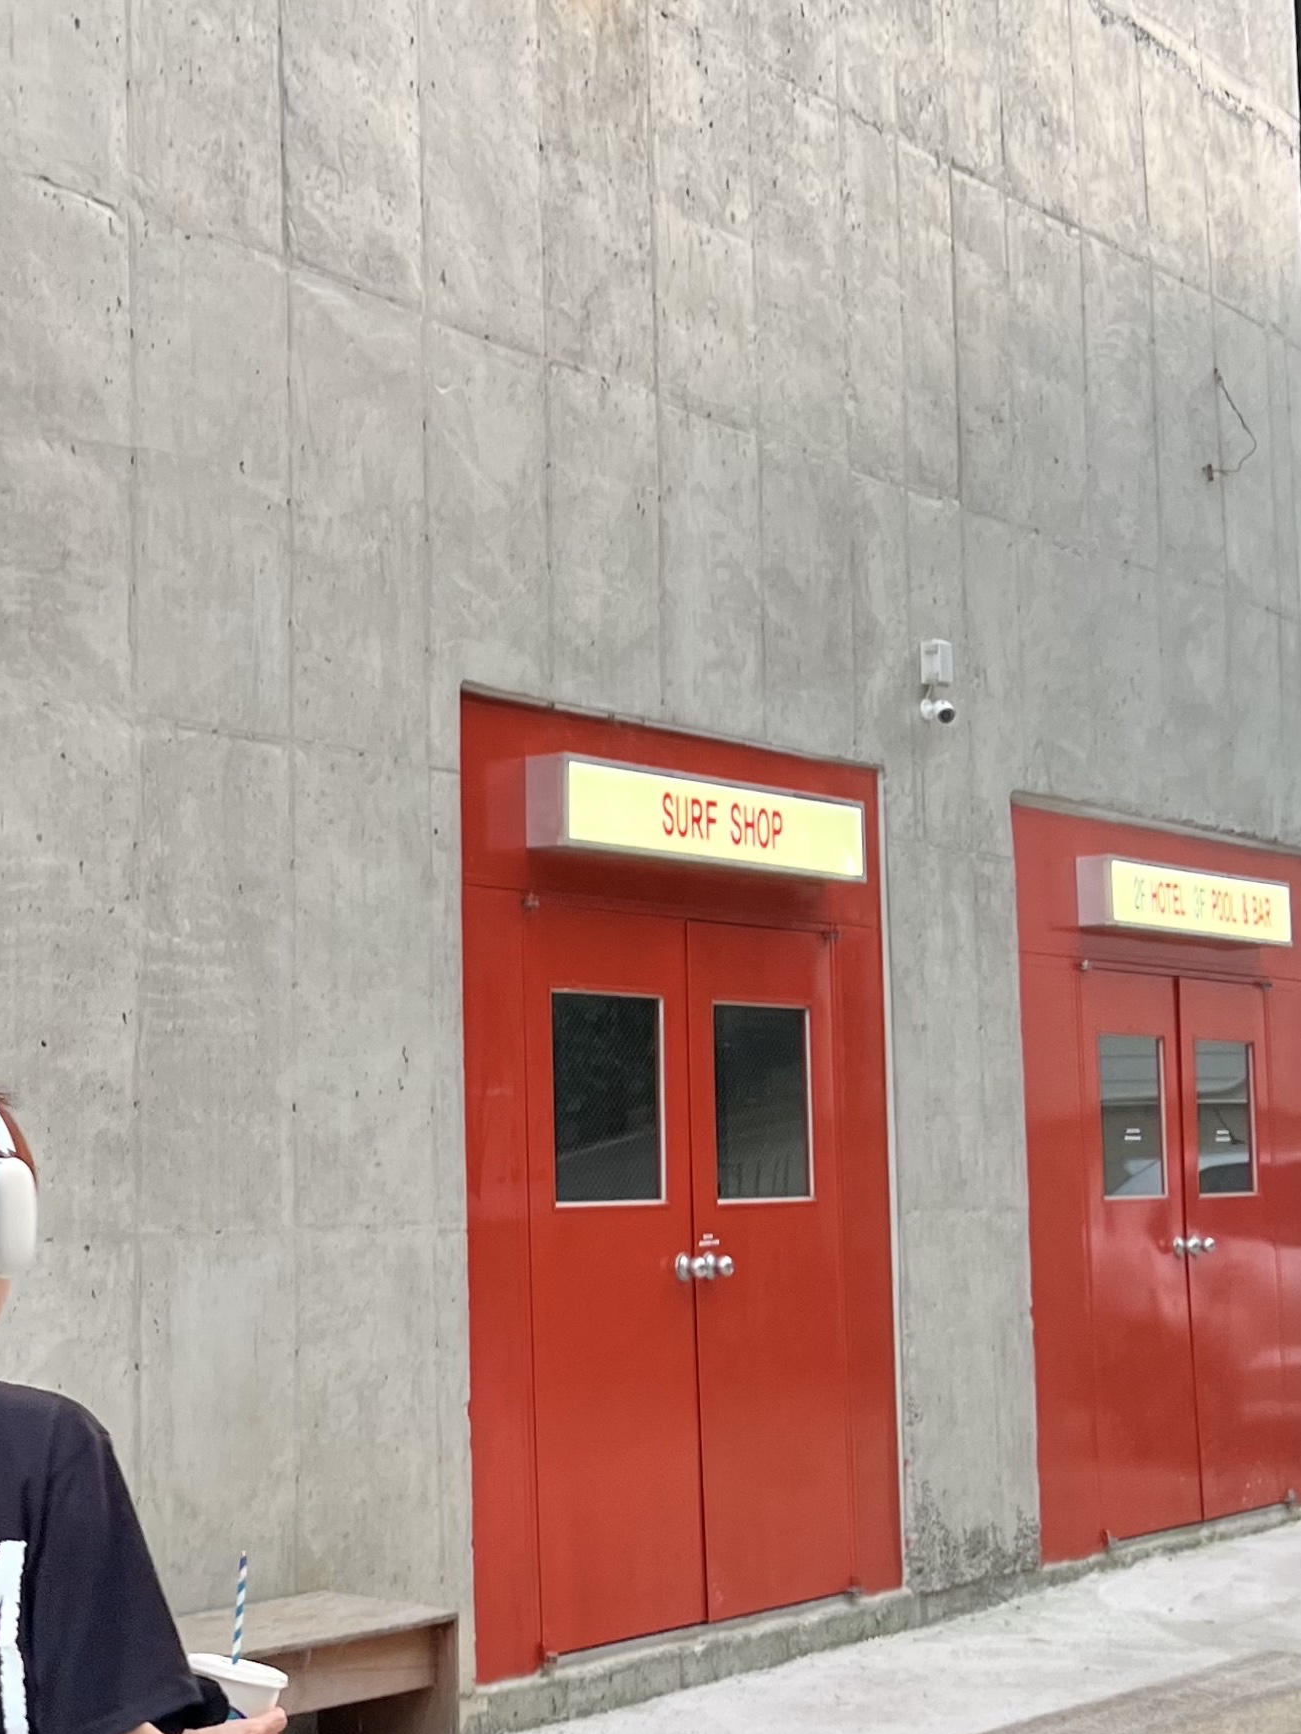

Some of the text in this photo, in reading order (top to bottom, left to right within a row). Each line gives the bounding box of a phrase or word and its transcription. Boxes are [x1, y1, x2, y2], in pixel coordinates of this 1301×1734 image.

[661, 791, 784, 850] SURF SHOP
[1150, 880, 1186, 916] HOTEL
[1211, 888, 1237, 924] POOL
[1252, 896, 1273, 928] BAR
